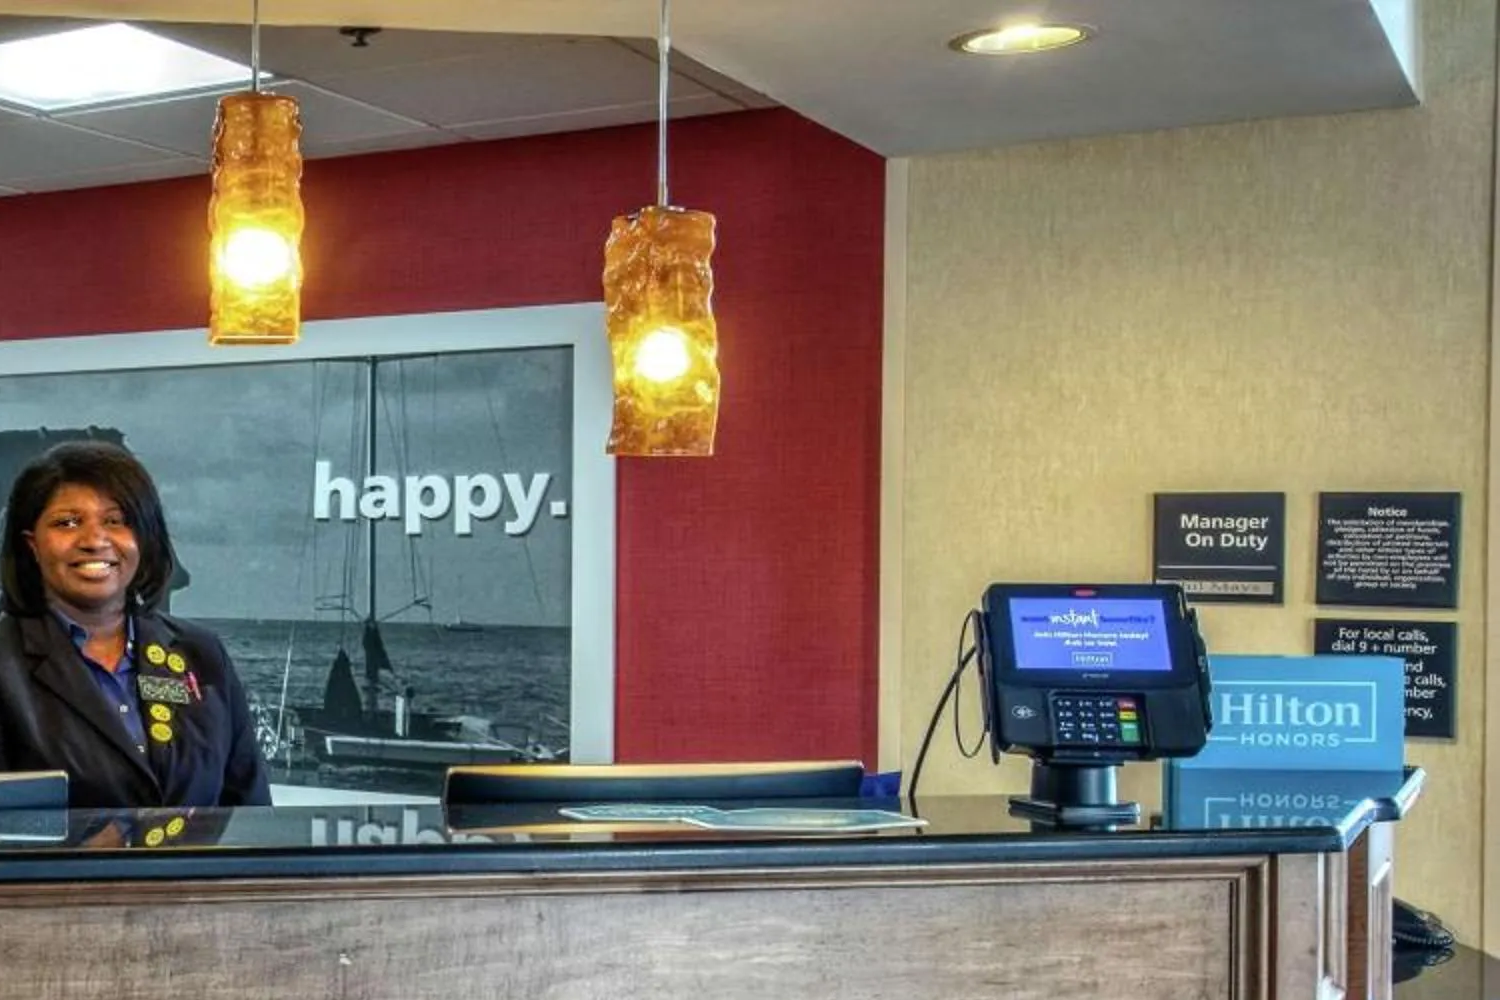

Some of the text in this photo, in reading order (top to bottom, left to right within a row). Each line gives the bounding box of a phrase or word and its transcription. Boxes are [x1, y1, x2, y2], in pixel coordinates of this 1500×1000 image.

[313, 460, 568, 536] happy.
[1367, 507, 1408, 518] Notice
[1181, 513, 1269, 533] Manager
[1185, 533, 1269, 551] On Duty
[1339, 627, 1429, 643] For local calls,
[1331, 640, 1355, 652] dial
[1359, 641, 1367, 653] 9
[1383, 643, 1438, 655] number
[1415, 674, 1447, 688] calls,
[1220, 693, 1362, 727] Hilton
[1240, 732, 1342, 748] HONORS
